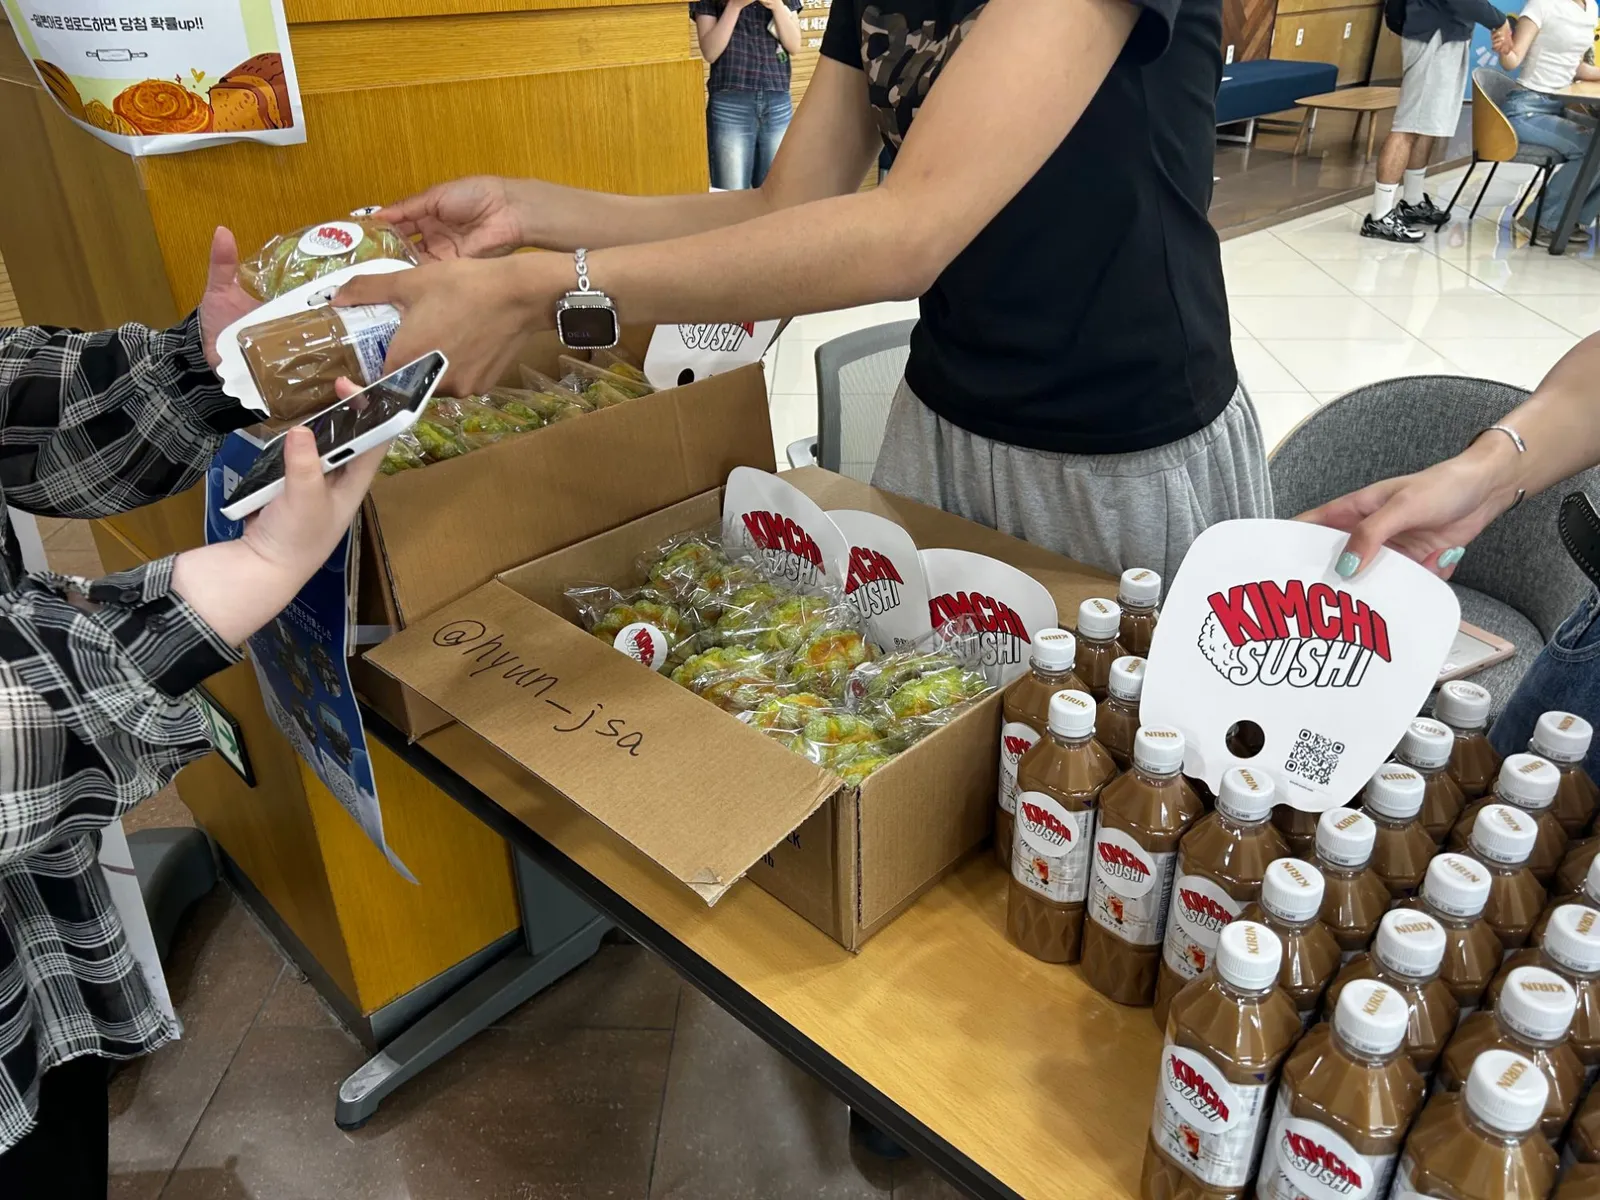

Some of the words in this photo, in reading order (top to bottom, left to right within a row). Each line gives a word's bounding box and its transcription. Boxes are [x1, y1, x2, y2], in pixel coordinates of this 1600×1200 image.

[64, 16, 117, 32] 업로드하면
[120, 17, 148, 31] 당첨
[687, 323, 747, 352] SUSHI
[741, 511, 826, 576] KIMCHI
[1207, 579, 1391, 663] KIMCHI
[1040, 634, 1069, 642] KIRIN
[1228, 637, 1373, 688] SUSHI
[433, 619, 639, 757] @hyun_jsa
[1058, 693, 1089, 709] KIRIN
[1144, 731, 1178, 739] KIRIN
[1238, 768, 1260, 791] KIRIN
[1380, 772, 1417, 781] KIRIN
[1022, 801, 1072, 843] KIMCHI
[1026, 821, 1066, 847] SUSHI
[1334, 813, 1363, 831] KIRIN
[1098, 842, 1151, 877] KIMCHI
[1106, 862, 1145, 883] SUSHI
[1443, 857, 1481, 883] KIRIN
[1282, 861, 1311, 888] KIRIN
[1243, 925, 1260, 954] KIRIN
[1394, 921, 1435, 934] KIRIN
[1362, 987, 1389, 1016] KIRIN
[1520, 981, 1566, 993] KIRIN
[1171, 1053, 1230, 1123] KIMCHI
[1495, 1060, 1528, 1089] KIRIN
[1173, 1077, 1220, 1122] SUSHI
[1285, 1129, 1362, 1189] KIMCHI
[1293, 1154, 1353, 1194] SUSHI
